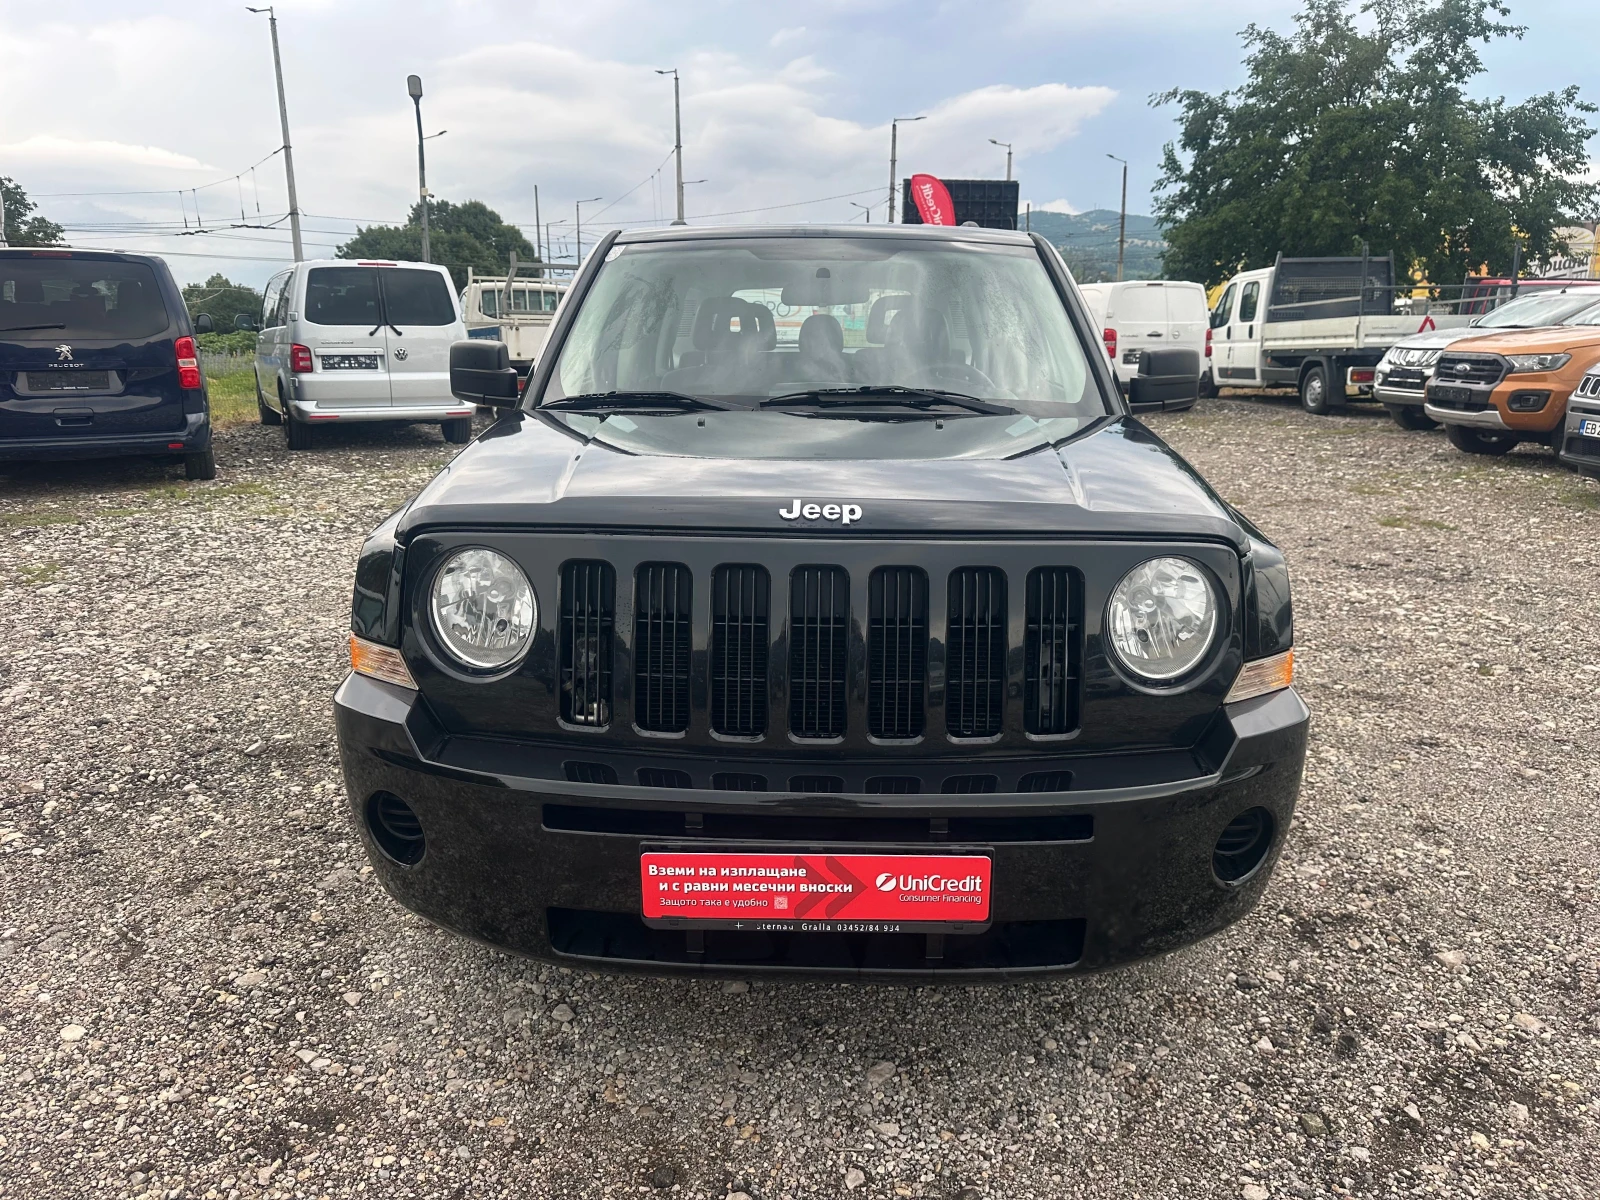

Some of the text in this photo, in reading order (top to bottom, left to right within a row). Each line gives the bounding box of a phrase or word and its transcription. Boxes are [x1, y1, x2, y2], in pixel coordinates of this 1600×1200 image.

[779, 499, 862, 525] Jeep
[648, 864, 807, 878] Вземи на изплащане
[659, 882, 853, 893] и с равни месечни вноски
[899, 874, 983, 892] UniCredit
[660, 898, 697, 907] Защото
[732, 898, 768, 907] удобно
[899, 893, 982, 905] Consumer Financing
[801, 923, 831, 931] Gralla
[837, 924, 879, 932] 03452/84
